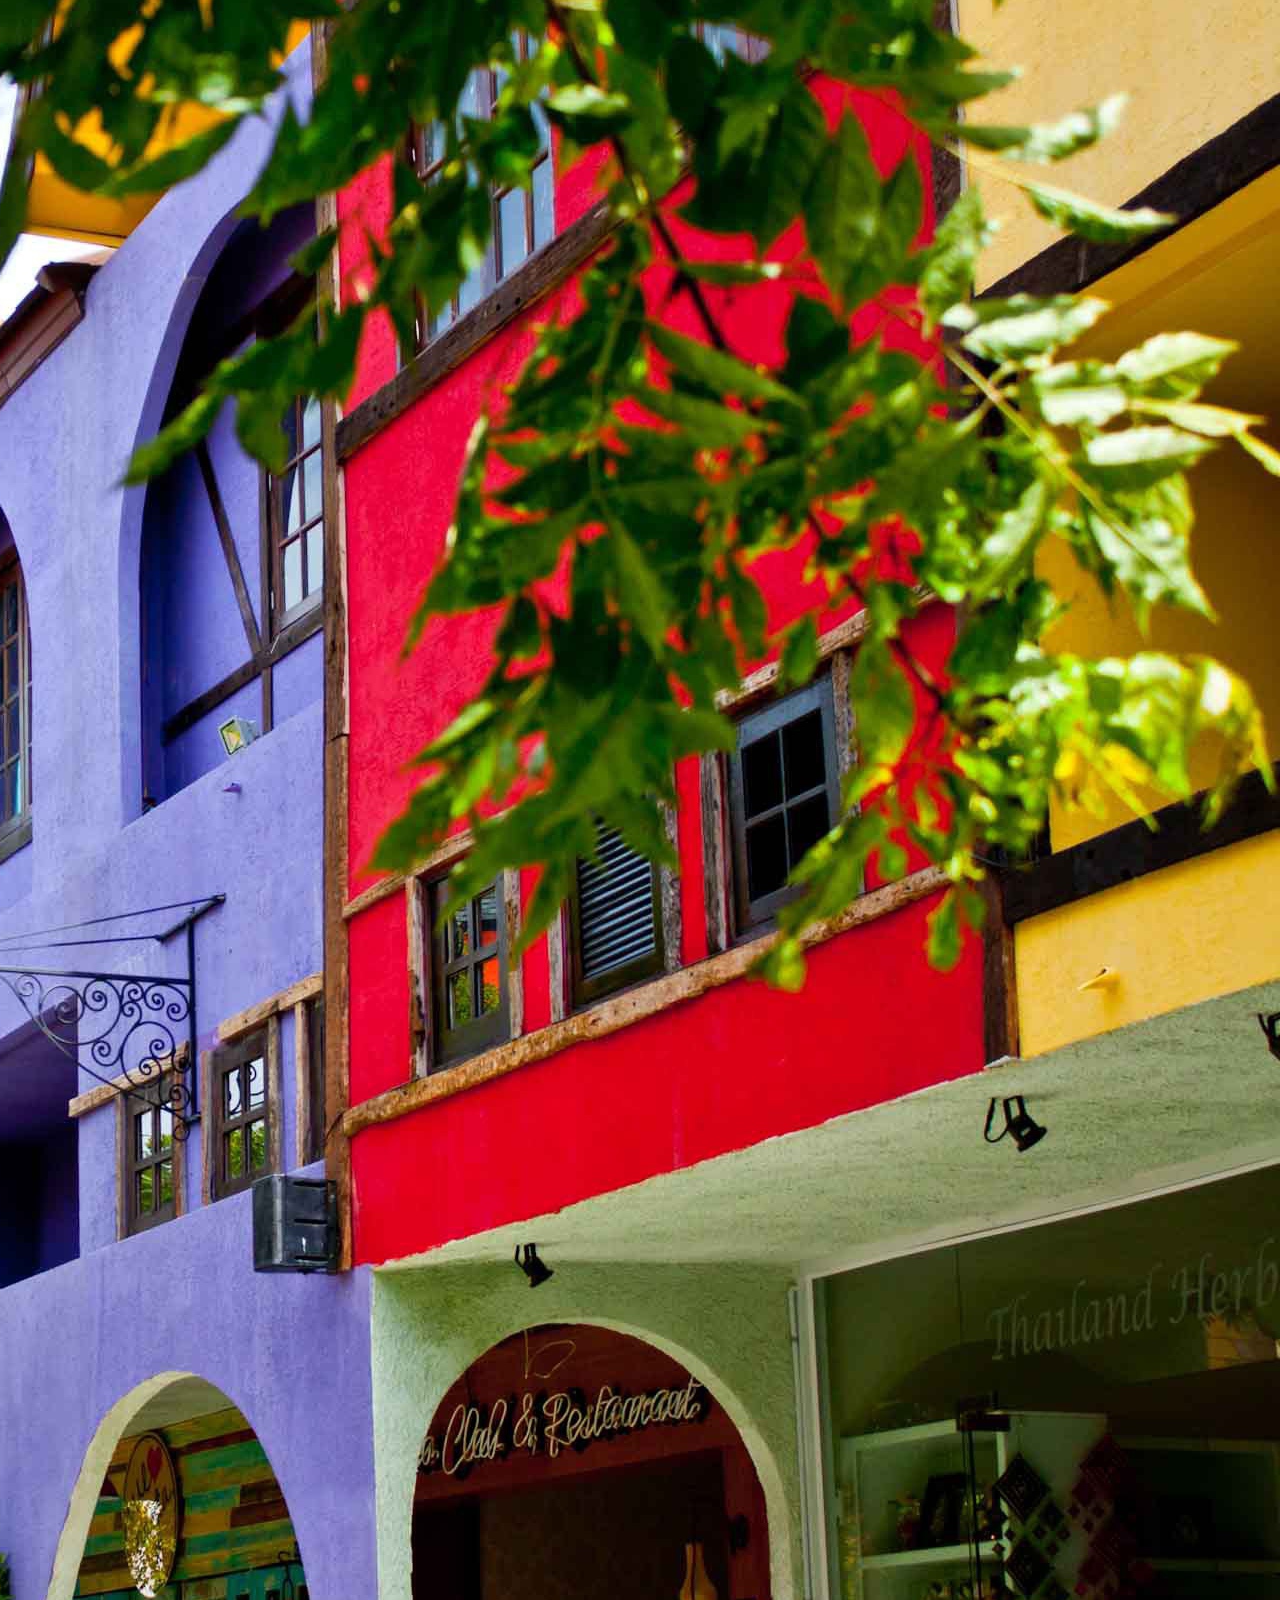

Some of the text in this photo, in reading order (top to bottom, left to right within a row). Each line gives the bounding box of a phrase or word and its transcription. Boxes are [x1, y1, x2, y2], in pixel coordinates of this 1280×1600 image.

[986, 1262, 1163, 1361] Thailand
[512, 1393, 538, 1455] &
[542, 1374, 704, 1458] Restaurant
